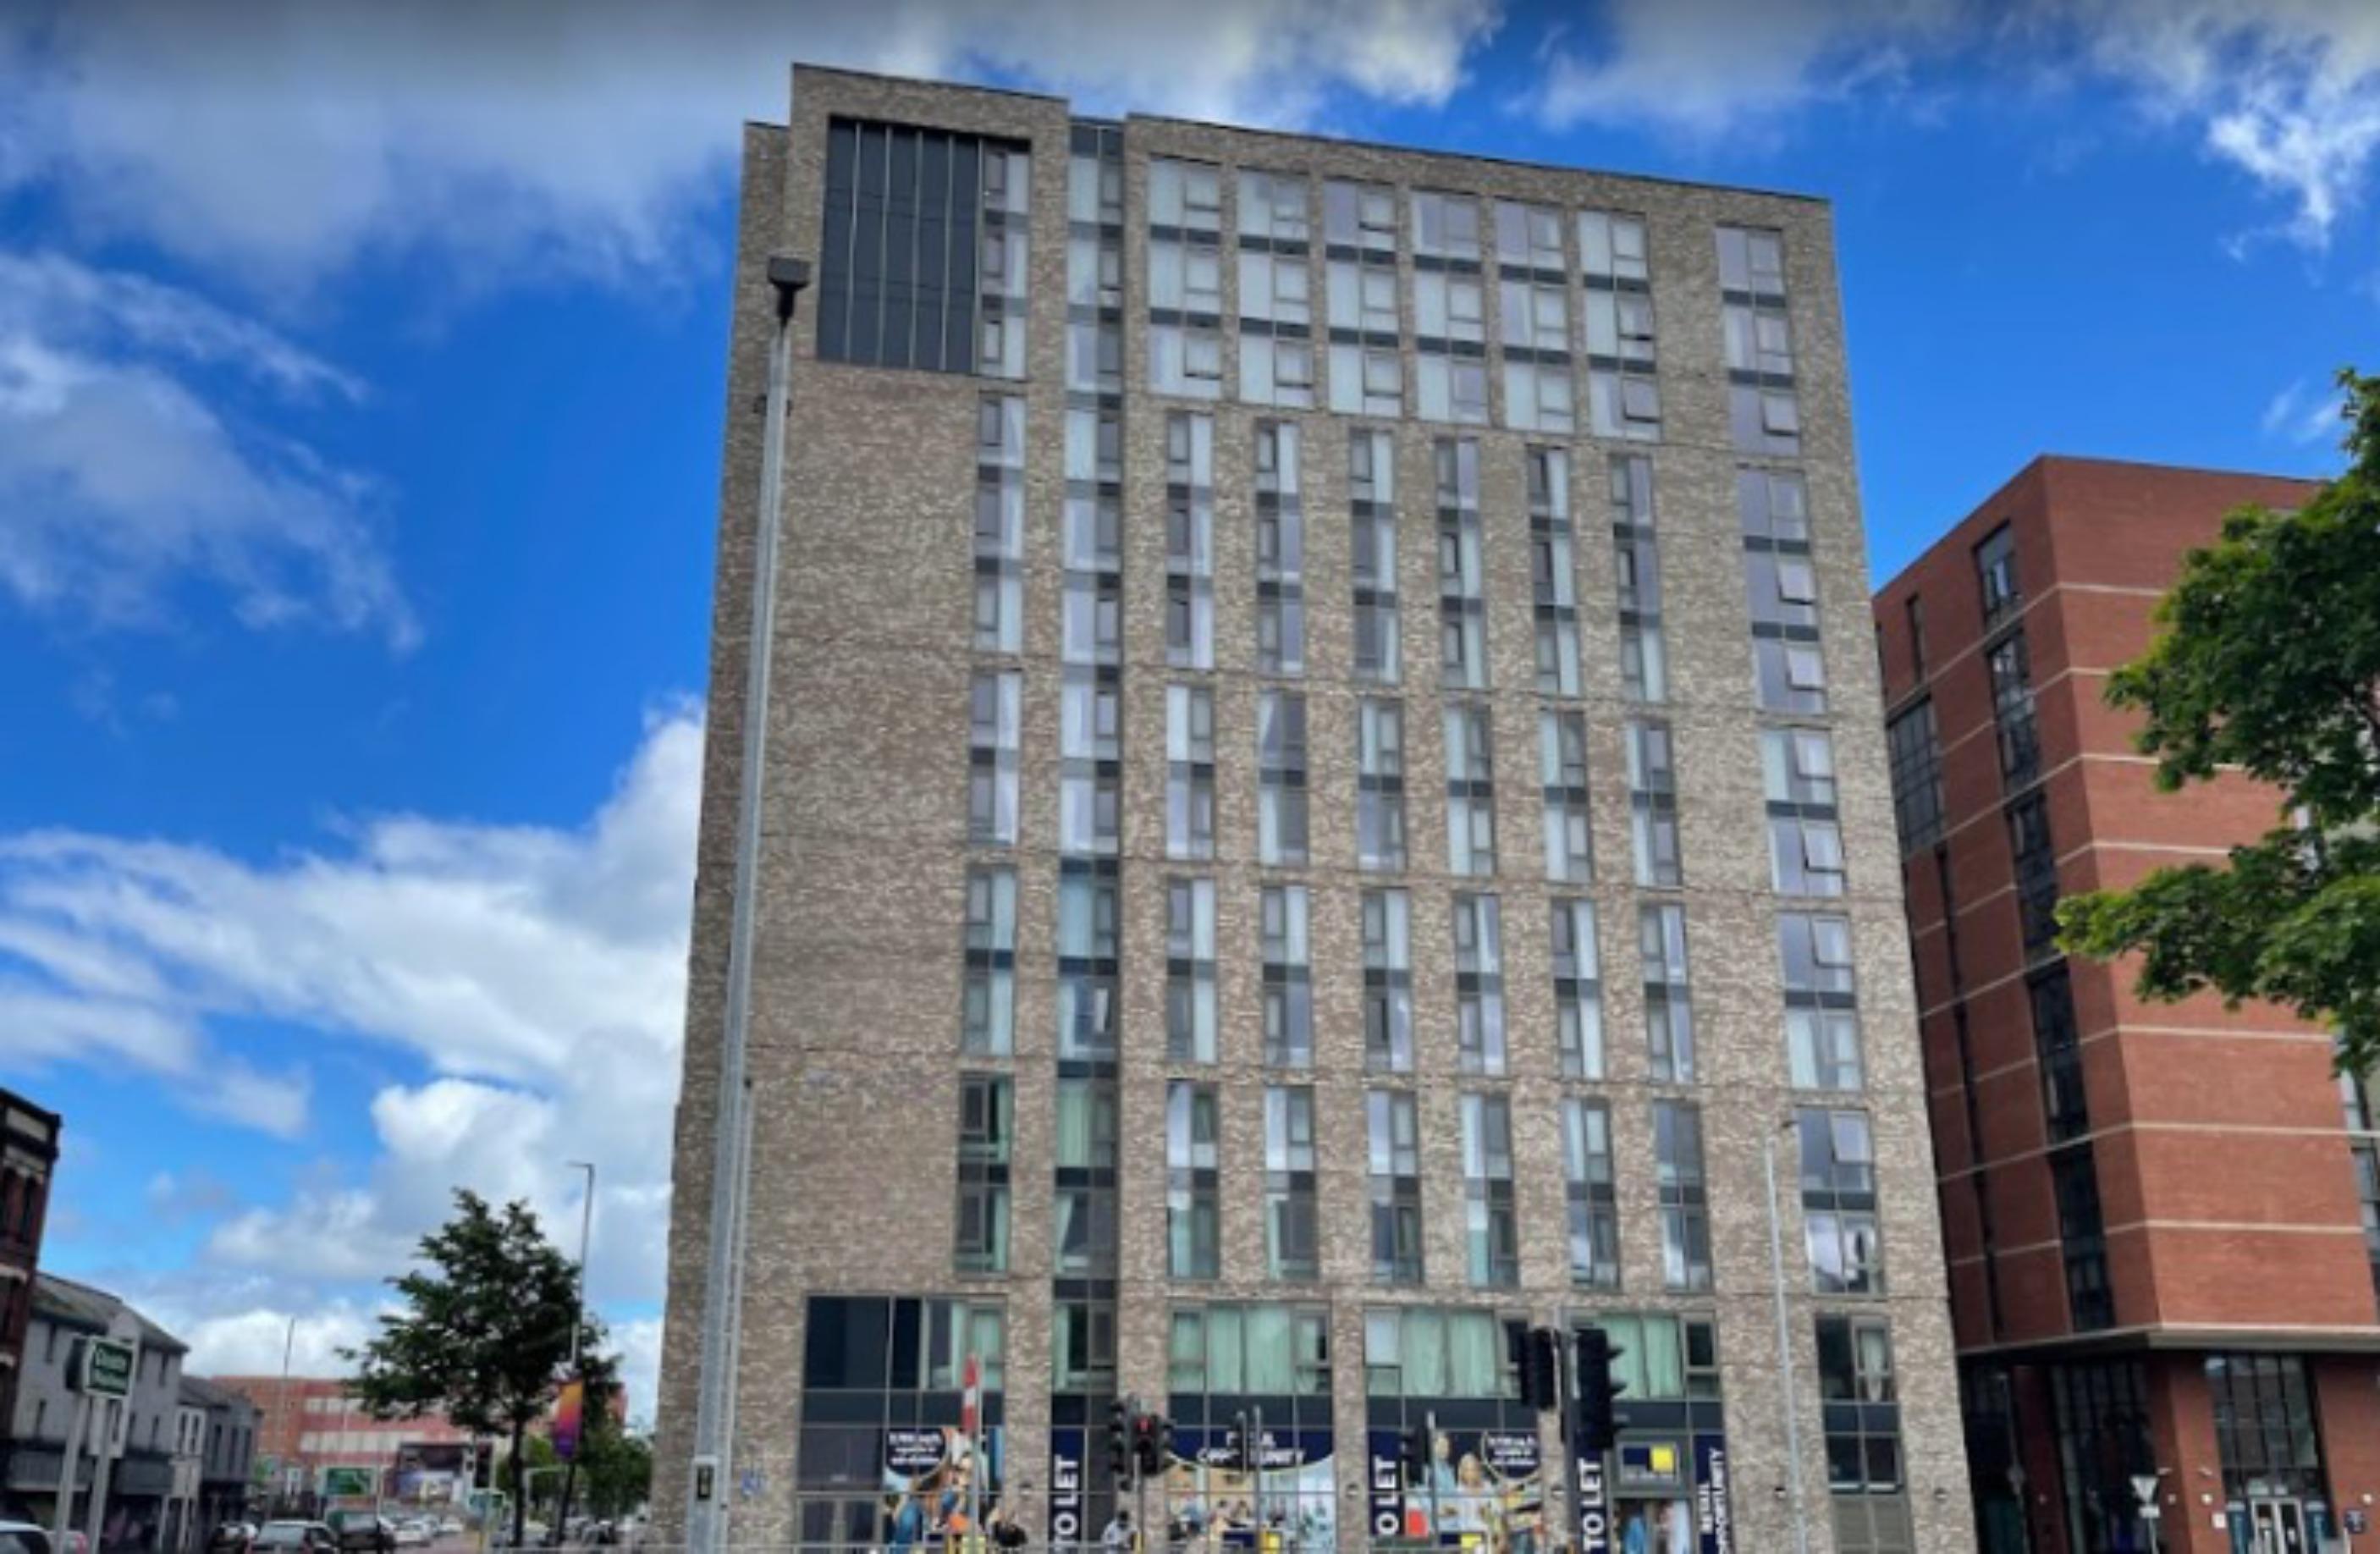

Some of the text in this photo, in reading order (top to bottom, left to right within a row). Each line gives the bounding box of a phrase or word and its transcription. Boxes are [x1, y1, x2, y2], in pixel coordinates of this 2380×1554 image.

[1054, 1453, 1079, 1552] TO LET
[1374, 1455, 1399, 1506] LET
[1576, 1457, 1606, 1552] TO LET
